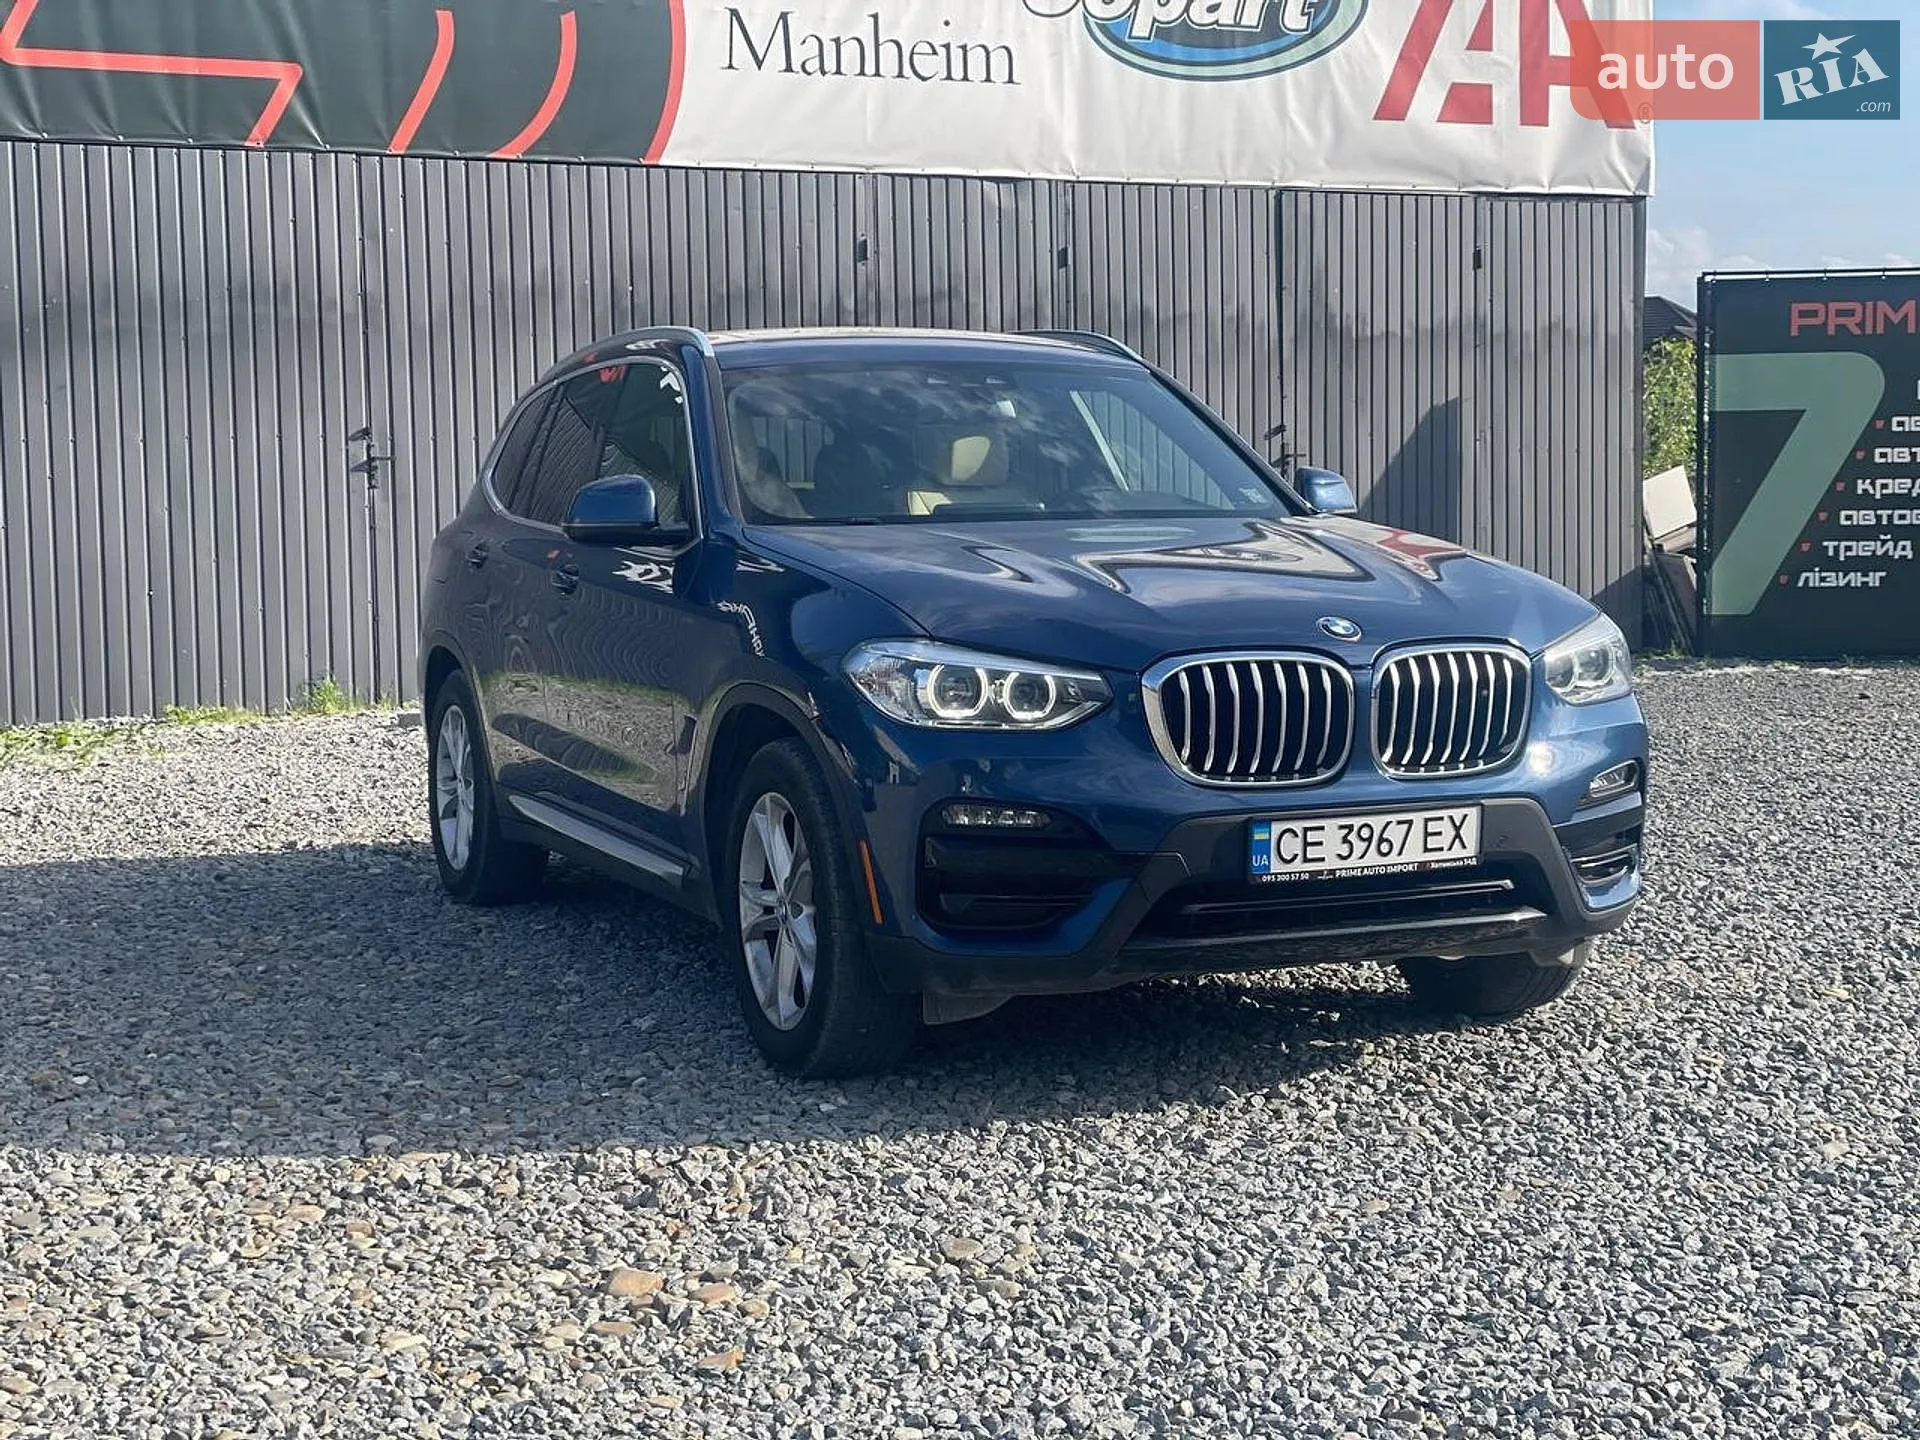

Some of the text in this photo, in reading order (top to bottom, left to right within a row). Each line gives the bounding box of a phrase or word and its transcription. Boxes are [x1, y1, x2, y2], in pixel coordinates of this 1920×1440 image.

[1020, 0, 1316, 41] part
[720, 7, 1021, 85] Manheim
[1790, 300, 1917, 336] PRIM
[1822, 534, 1913, 560] трейд
[1797, 566, 1887, 587] лізинг
[1276, 813, 1468, 865] CE 3967 EX
[1252, 855, 1269, 867] UA
[1335, 869, 1362, 878] PRIME
[1363, 867, 1386, 876] AUTO
[1387, 863, 1419, 873] IMPORT
